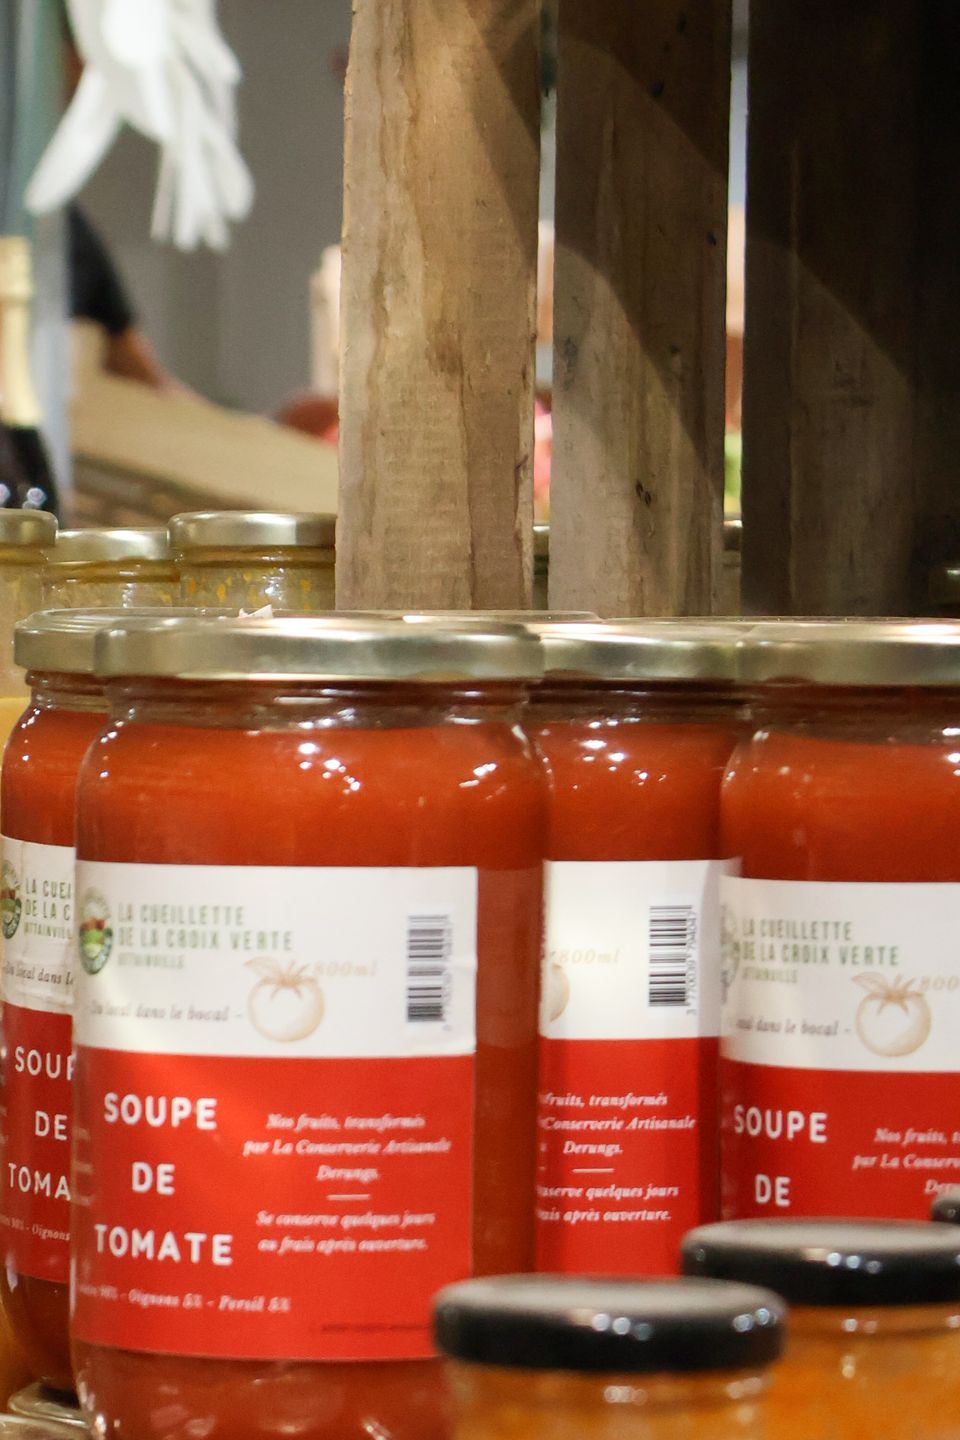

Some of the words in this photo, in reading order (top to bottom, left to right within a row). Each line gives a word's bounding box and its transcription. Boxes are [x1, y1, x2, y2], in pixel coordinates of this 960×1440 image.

[117, 902, 133, 923] LA
[140, 904, 246, 926] CUEILLETTE
[140, 928, 159, 948] LA
[166, 929, 220, 950] CROIX
[230, 930, 295, 952] VERTE
[743, 918, 756, 936] LA
[760, 918, 853, 941] CUEILLETTE
[760, 943, 776, 962] LA
[781, 944, 830, 964] CROIX
[838, 946, 900, 966] VERTE
[104, 1091, 218, 1130] SOUPE
[626, 1114, 698, 1131] Artisanale
[734, 1104, 829, 1143] SOUPE
[34, 1110, 68, 1141] DE
[880, 1154, 901, 1168] La
[132, 1161, 176, 1196] DE
[755, 1173, 791, 1208] DE
[94, 1223, 234, 1266] TOMATE
